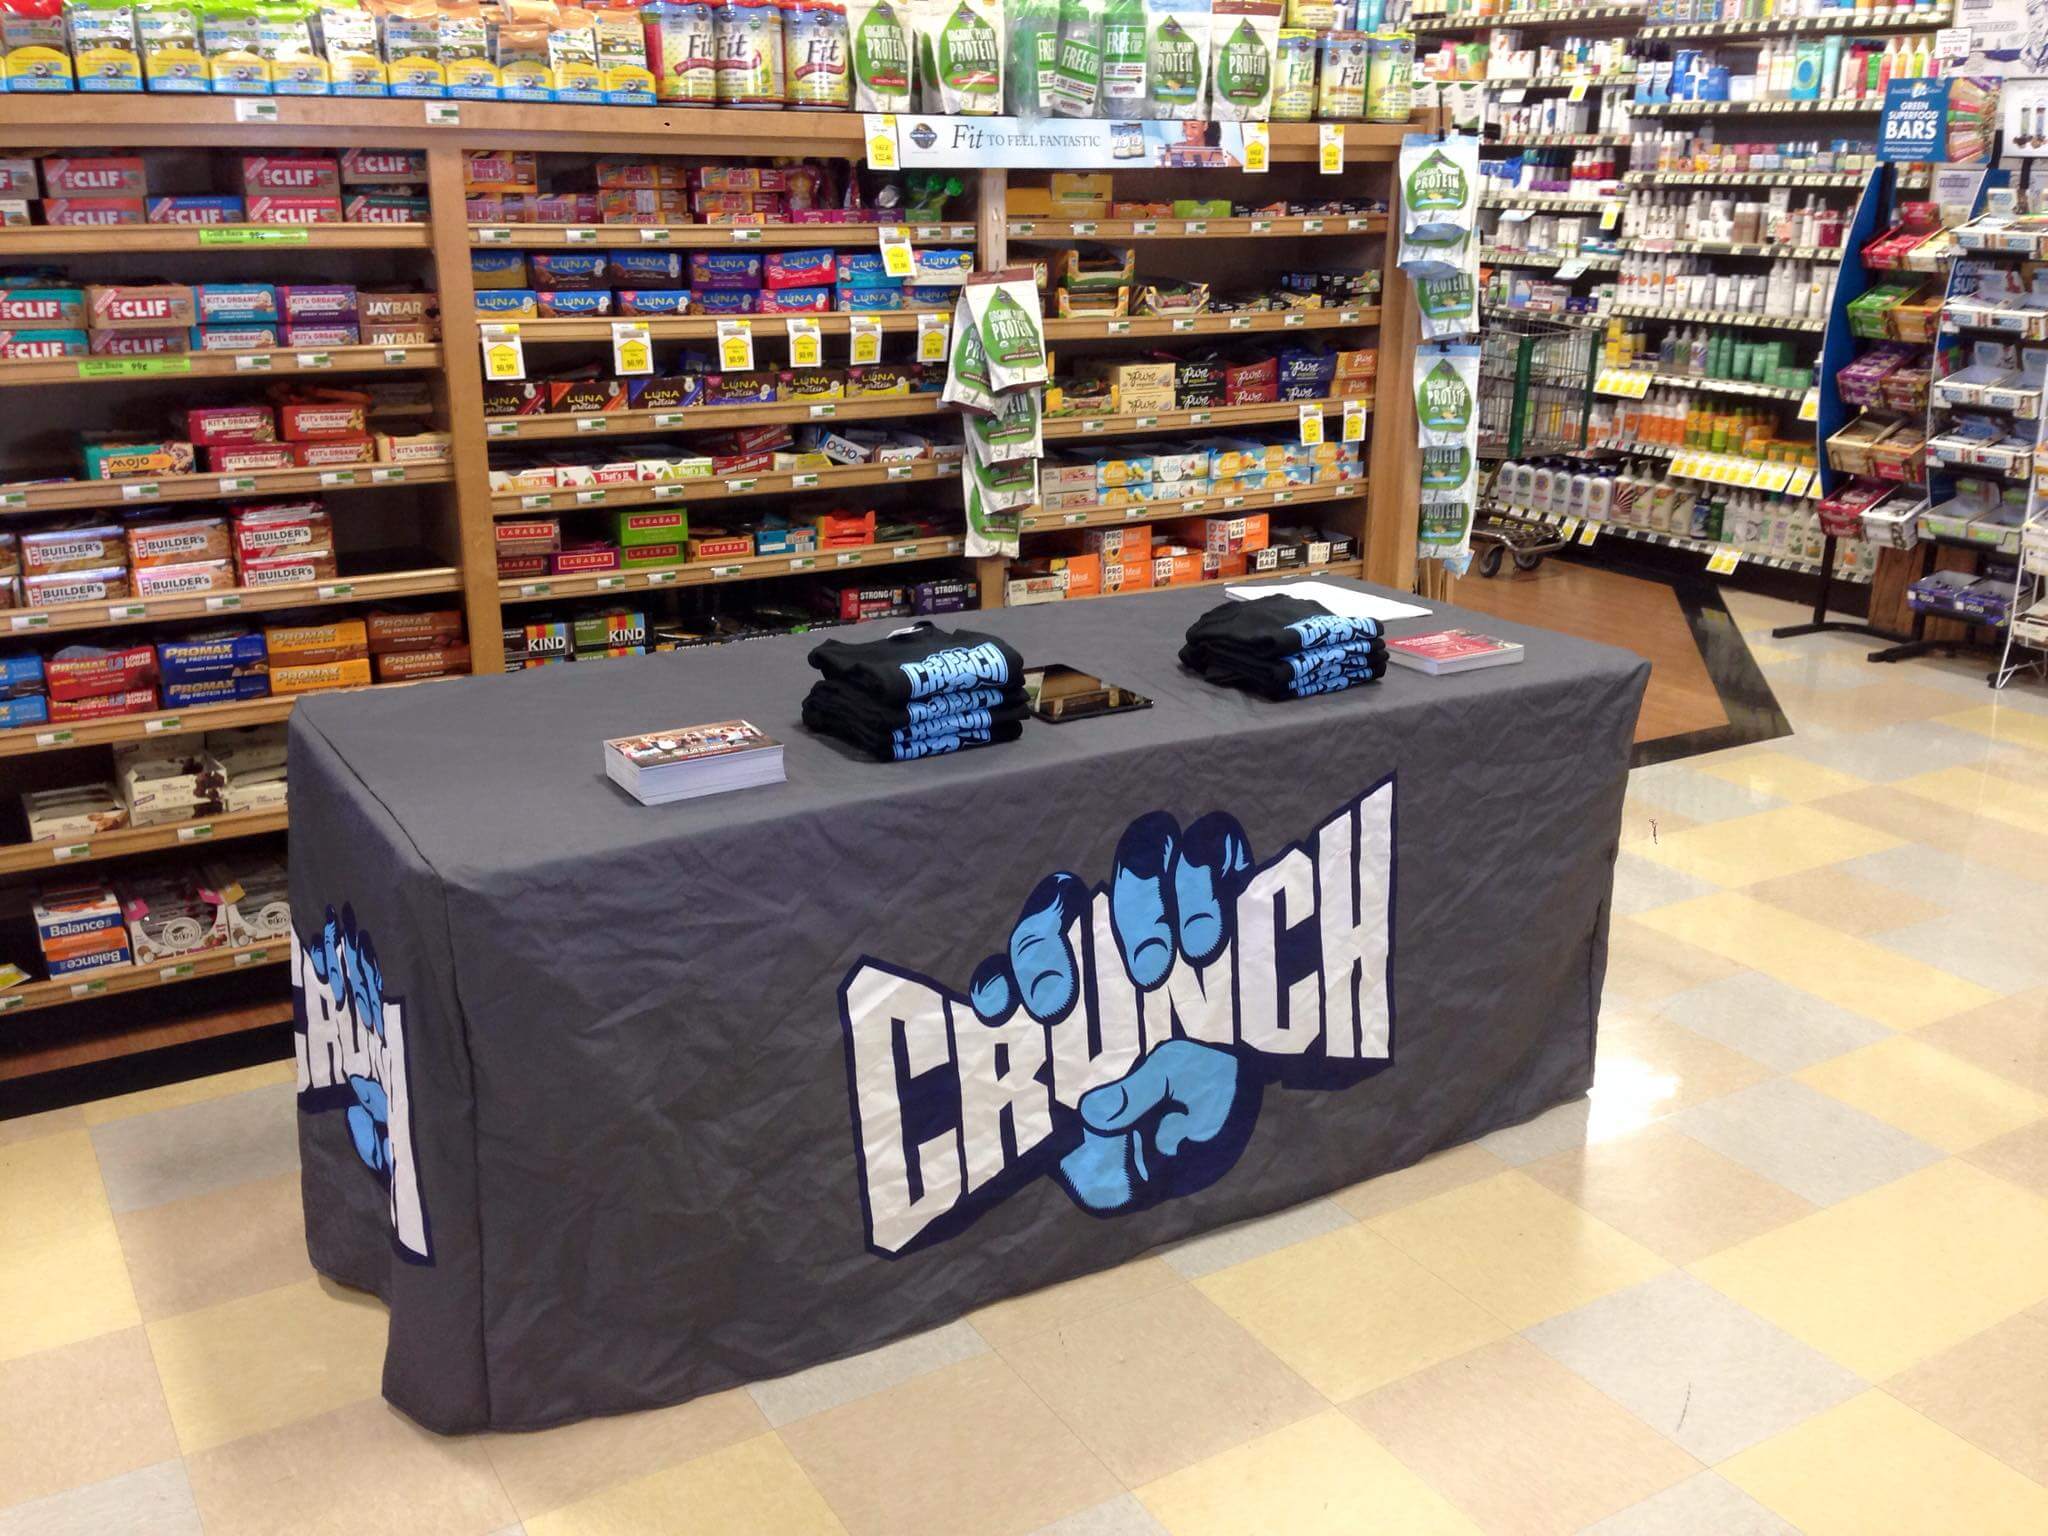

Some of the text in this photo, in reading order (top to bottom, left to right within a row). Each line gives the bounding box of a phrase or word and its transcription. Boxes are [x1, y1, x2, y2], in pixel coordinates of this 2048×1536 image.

[716, 33, 748, 60] Fit
[807, 39, 840, 64] Fit
[867, 38, 907, 61] PROTEIN
[950, 40, 996, 62] PROTEIN
[1063, 45, 1088, 71] FREE
[1229, 54, 1266, 75] PROTEIN
[1288, 58, 1313, 82] Fit
[1340, 63, 1365, 87] Fit
[1388, 62, 1414, 85] Fit
[1900, 101, 1930, 110] GREEN
[1888, 111, 1940, 120] SUPERFOOD
[1885, 120, 1938, 140] BARS
[952, 124, 1101, 150] Fit TO FEEL FANTASTIC
[365, 157, 406, 173] CLIF
[73, 171, 120, 187] CLIF
[272, 169, 315, 185] CLIF
[1415, 175, 1459, 191] PROTEIN
[72, 210, 118, 225] CLIF
[176, 208, 220, 225] CLIF
[276, 209, 318, 223] CLIF
[369, 209, 410, 223] CLIF
[552, 259, 591, 270] LUNA
[627, 256, 665, 267] LUNA
[708, 259, 745, 270] LUNA
[783, 256, 820, 269] LUNA
[922, 257, 959, 268] LUNA
[477, 298, 519, 309] LUNA
[555, 296, 596, 308] LUNA
[636, 296, 675, 307] LUNA
[702, 294, 739, 304] LUNA
[777, 293, 814, 305] LUNA
[853, 293, 888, 303] LUNA
[11, 302, 58, 318] CLIF
[121, 300, 168, 317] CLIF
[366, 302, 422, 316] JAYBAR
[992, 320, 1034, 341] PROTEIN
[372, 333, 426, 344] JAYBAR
[15, 343, 64, 358] CLIF
[118, 339, 164, 354] CLIF
[793, 377, 830, 386] LUNA
[861, 373, 896, 382] LUNA
[721, 381, 759, 390] LUNA
[797, 385, 825, 394] protein
[567, 395, 604, 404] LUNA
[644, 391, 680, 399] LUNA
[1428, 389, 1465, 406] PROTEIN
[484, 397, 520, 406] LUNA
[570, 403, 601, 412] protein
[826, 440, 857, 461] OCHO
[111, 457, 150, 469] MOJO
[599, 472, 622, 481] That's
[678, 467, 700, 476] That's
[632, 515, 679, 527] LARABAR
[254, 528, 309, 542] BUILDER's
[500, 528, 550, 537] LARABAR
[1106, 531, 1122, 540] PRO
[147, 536, 205, 551] BUILDER's
[702, 543, 747, 554] LARABAR
[40, 542, 102, 558] BUILDER's
[629, 547, 677, 558] LARABAR
[1259, 550, 1276, 558] PRO
[562, 555, 611, 567] LARABAR
[1157, 559, 1172, 568] PRO
[1175, 560, 1191, 569] Meal
[1259, 559, 1276, 567] BAR
[257, 567, 313, 581] BUILDER's
[1107, 566, 1123, 575] PRO
[1126, 567, 1142, 576] Meal
[1157, 567, 1172, 576] BAR
[1071, 572, 1089, 582] Meal
[151, 576, 211, 591] BUILDER's
[42, 584, 103, 599] BUILDER's
[860, 591, 889, 600] STRONG
[934, 585, 963, 595] STRONG
[374, 616, 433, 628] PROMAX
[271, 628, 336, 642] PROMAX
[609, 628, 645, 642] KIND
[528, 636, 566, 651] KIND
[125, 652, 151, 662] LOWER
[165, 644, 233, 660] PROMAX
[189, 655, 218, 663] PROTEIN
[219, 652, 233, 660] BAR
[384, 652, 444, 666] PROMAX
[276, 667, 340, 682] PROMAX
[900, 642, 1008, 699] CRUNCH
[169, 680, 236, 695] PROMAX
[126, 690, 153, 700] LOWER
[192, 690, 221, 698] PROTEIN
[49, 919, 105, 937] Balance
[67, 950, 121, 969] Balance
[846, 782, 1393, 1252] CRUNCH
